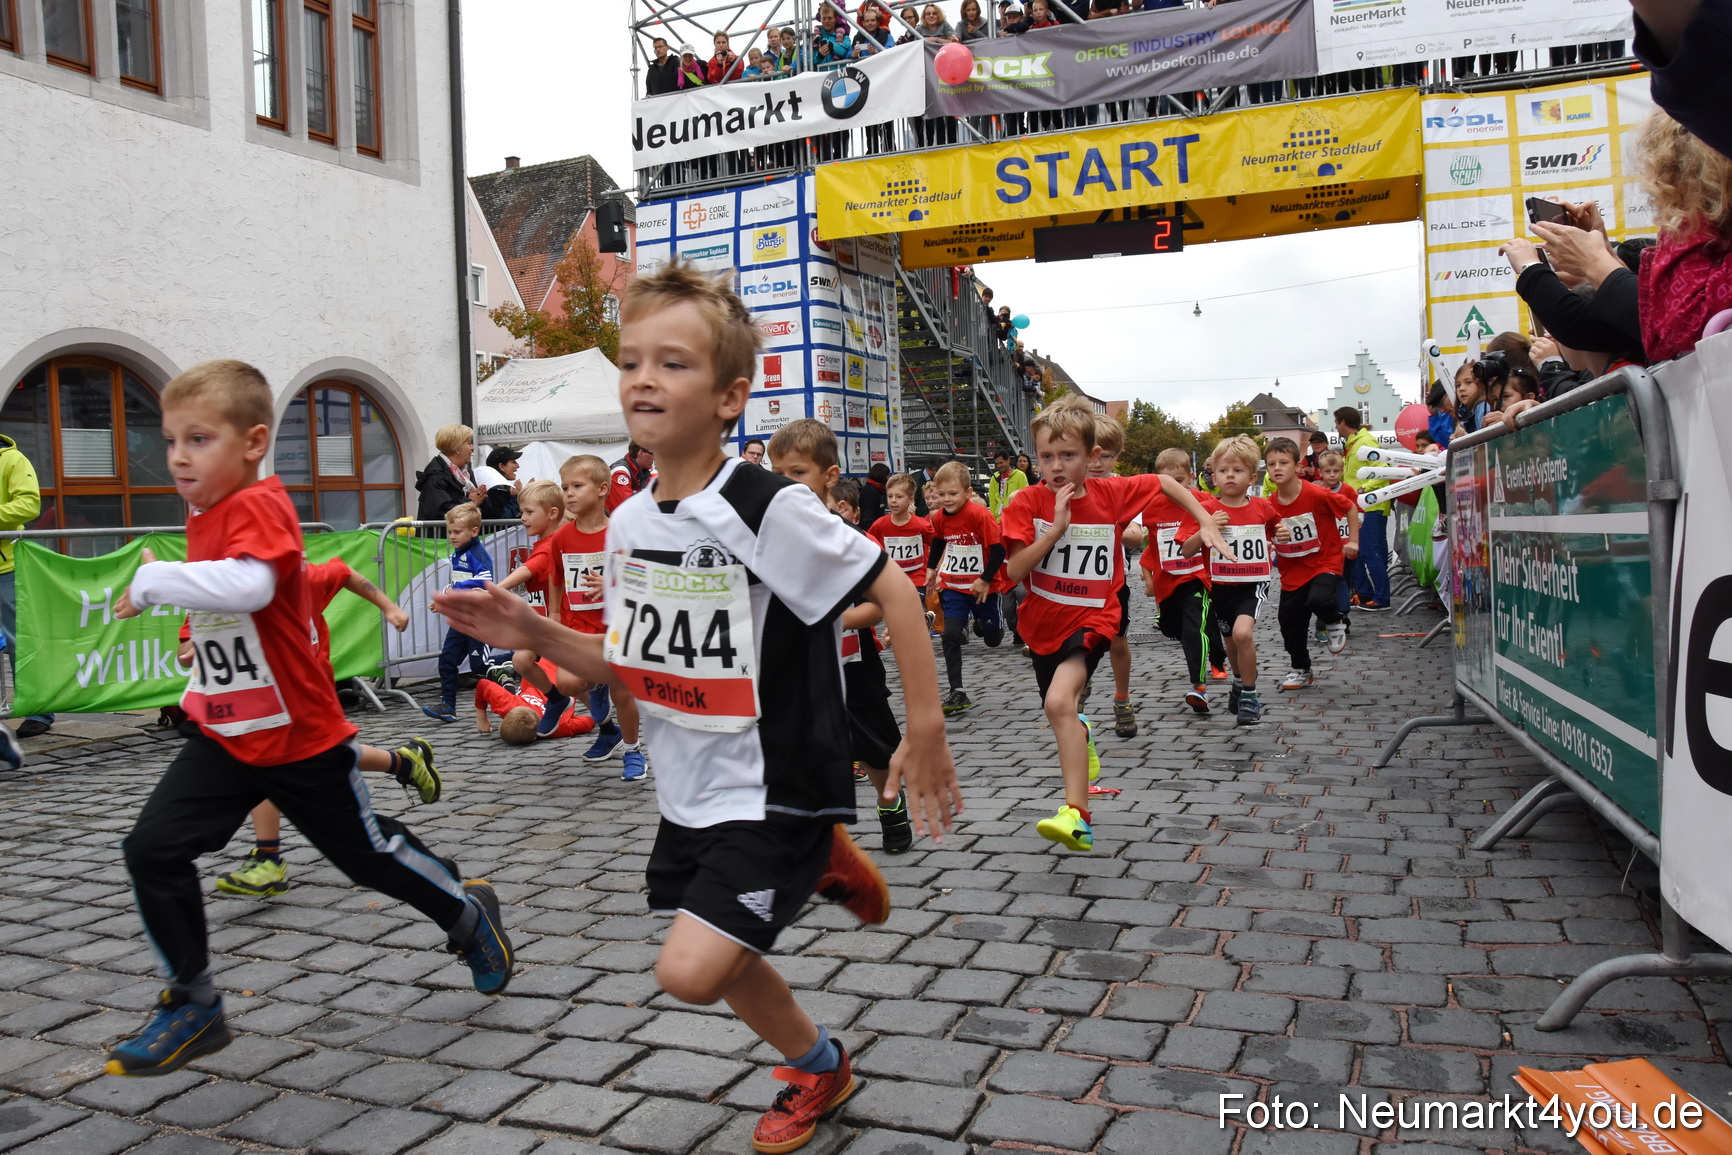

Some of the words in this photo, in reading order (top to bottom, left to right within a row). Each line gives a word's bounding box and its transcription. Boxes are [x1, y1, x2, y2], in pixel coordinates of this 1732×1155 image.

[1330, 6, 1406, 26] NeuerMarkt
[1075, 42, 1128, 63] OFFICE
[1133, 30, 1216, 55] INDUSTRY
[1221, 19, 1291, 41] LOUNGE
[1463, 38, 1472, 49] P
[970, 55, 1048, 79] OCK
[1106, 45, 1259, 78] www.bockonline.de
[823, 67, 868, 90] BMW
[974, 83, 985, 93] by
[987, 82, 1013, 91] smart
[1016, 80, 1056, 89] concepts
[1566, 112, 1591, 121] KANN
[1466, 125, 1504, 134] energie
[1242, 149, 1317, 166] Neumarkter
[1321, 139, 1383, 157] Stadtlauf
[1525, 152, 1577, 170] swn
[995, 133, 1200, 204] START
[1451, 153, 1480, 170] RUND
[1452, 168, 1484, 185] SCHAU
[1525, 168, 1560, 176] stadtwerke
[1561, 165, 1593, 174] neumarkt
[845, 197, 909, 211] Neumarkter
[911, 188, 963, 205] Stadtlauf
[1271, 197, 1336, 213] Neumarkter
[1339, 190, 1390, 206] Stadtlauf
[709, 204, 727, 214] CODE
[709, 211, 730, 221] CLINIC
[1430, 220, 1487, 232] RAIL.ONE
[756, 236, 785, 251] Burgis
[923, 236, 977, 248] Neumarkter
[979, 230, 1025, 243] Stadtlauf
[1154, 221, 1171, 250] 2
[1454, 266, 1511, 280] VARIOTEC
[773, 289, 798, 298] energie
[764, 373, 781, 383] Braun
[755, 422, 787, 432] Lammsb
[1506, 457, 1568, 492] Event-Leit-Systeme
[1071, 527, 1109, 537] BOCK
[889, 543, 919, 559] 7121
[947, 555, 979, 573] 7242
[1219, 564, 1264, 575] Maximilian
[654, 569, 730, 593] BOCK
[1496, 545, 1520, 587] Mehr
[1521, 547, 1580, 603] Sicherheit
[1054, 580, 1088, 595] Aiden
[622, 598, 737, 669] 7244
[1497, 599, 1510, 641] für
[1512, 604, 1526, 648] Ihr
[1528, 611, 1565, 669] Event!
[741, 665, 749, 676] K
[643, 676, 708, 709] Patrick
[1512, 689, 1518, 713] &
[1519, 691, 1541, 729] Service
[1541, 706, 1560, 743] Line:
[1561, 719, 1588, 762] 09181
[1589, 736, 1614, 781] 6352
